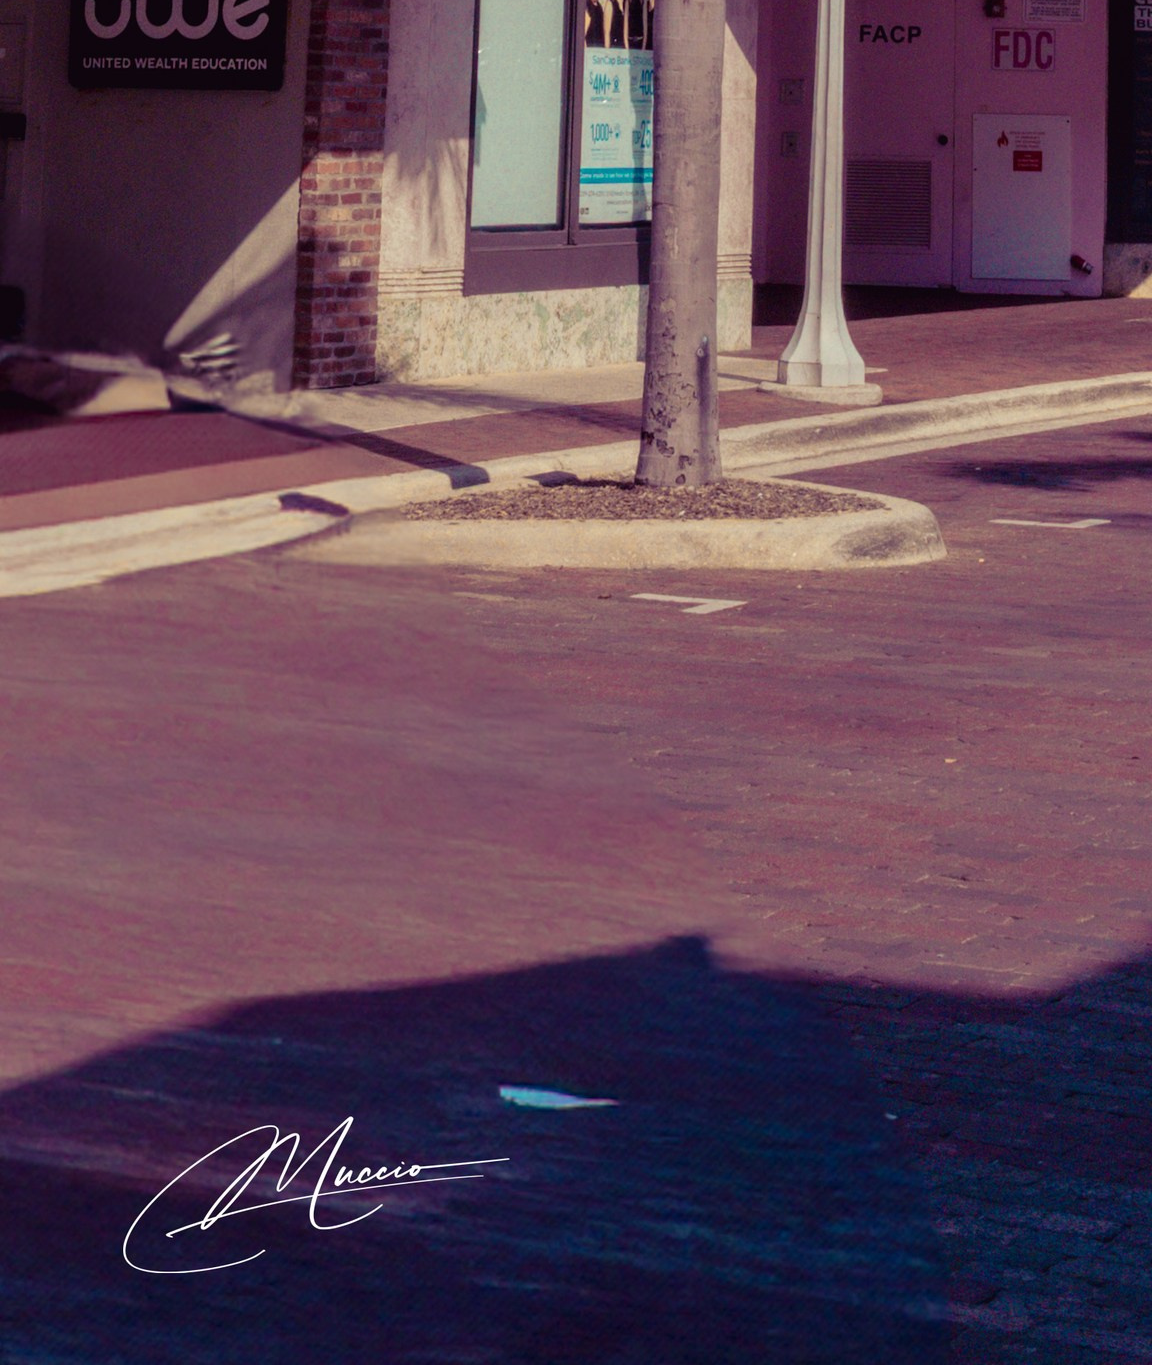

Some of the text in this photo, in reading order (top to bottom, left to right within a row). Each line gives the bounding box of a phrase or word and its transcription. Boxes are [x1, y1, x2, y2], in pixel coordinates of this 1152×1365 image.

[859, 25, 922, 43] FACP
[994, 30, 1053, 69] FDC
[83, 57, 267, 70] UNITED WEALTH EDUCATION
